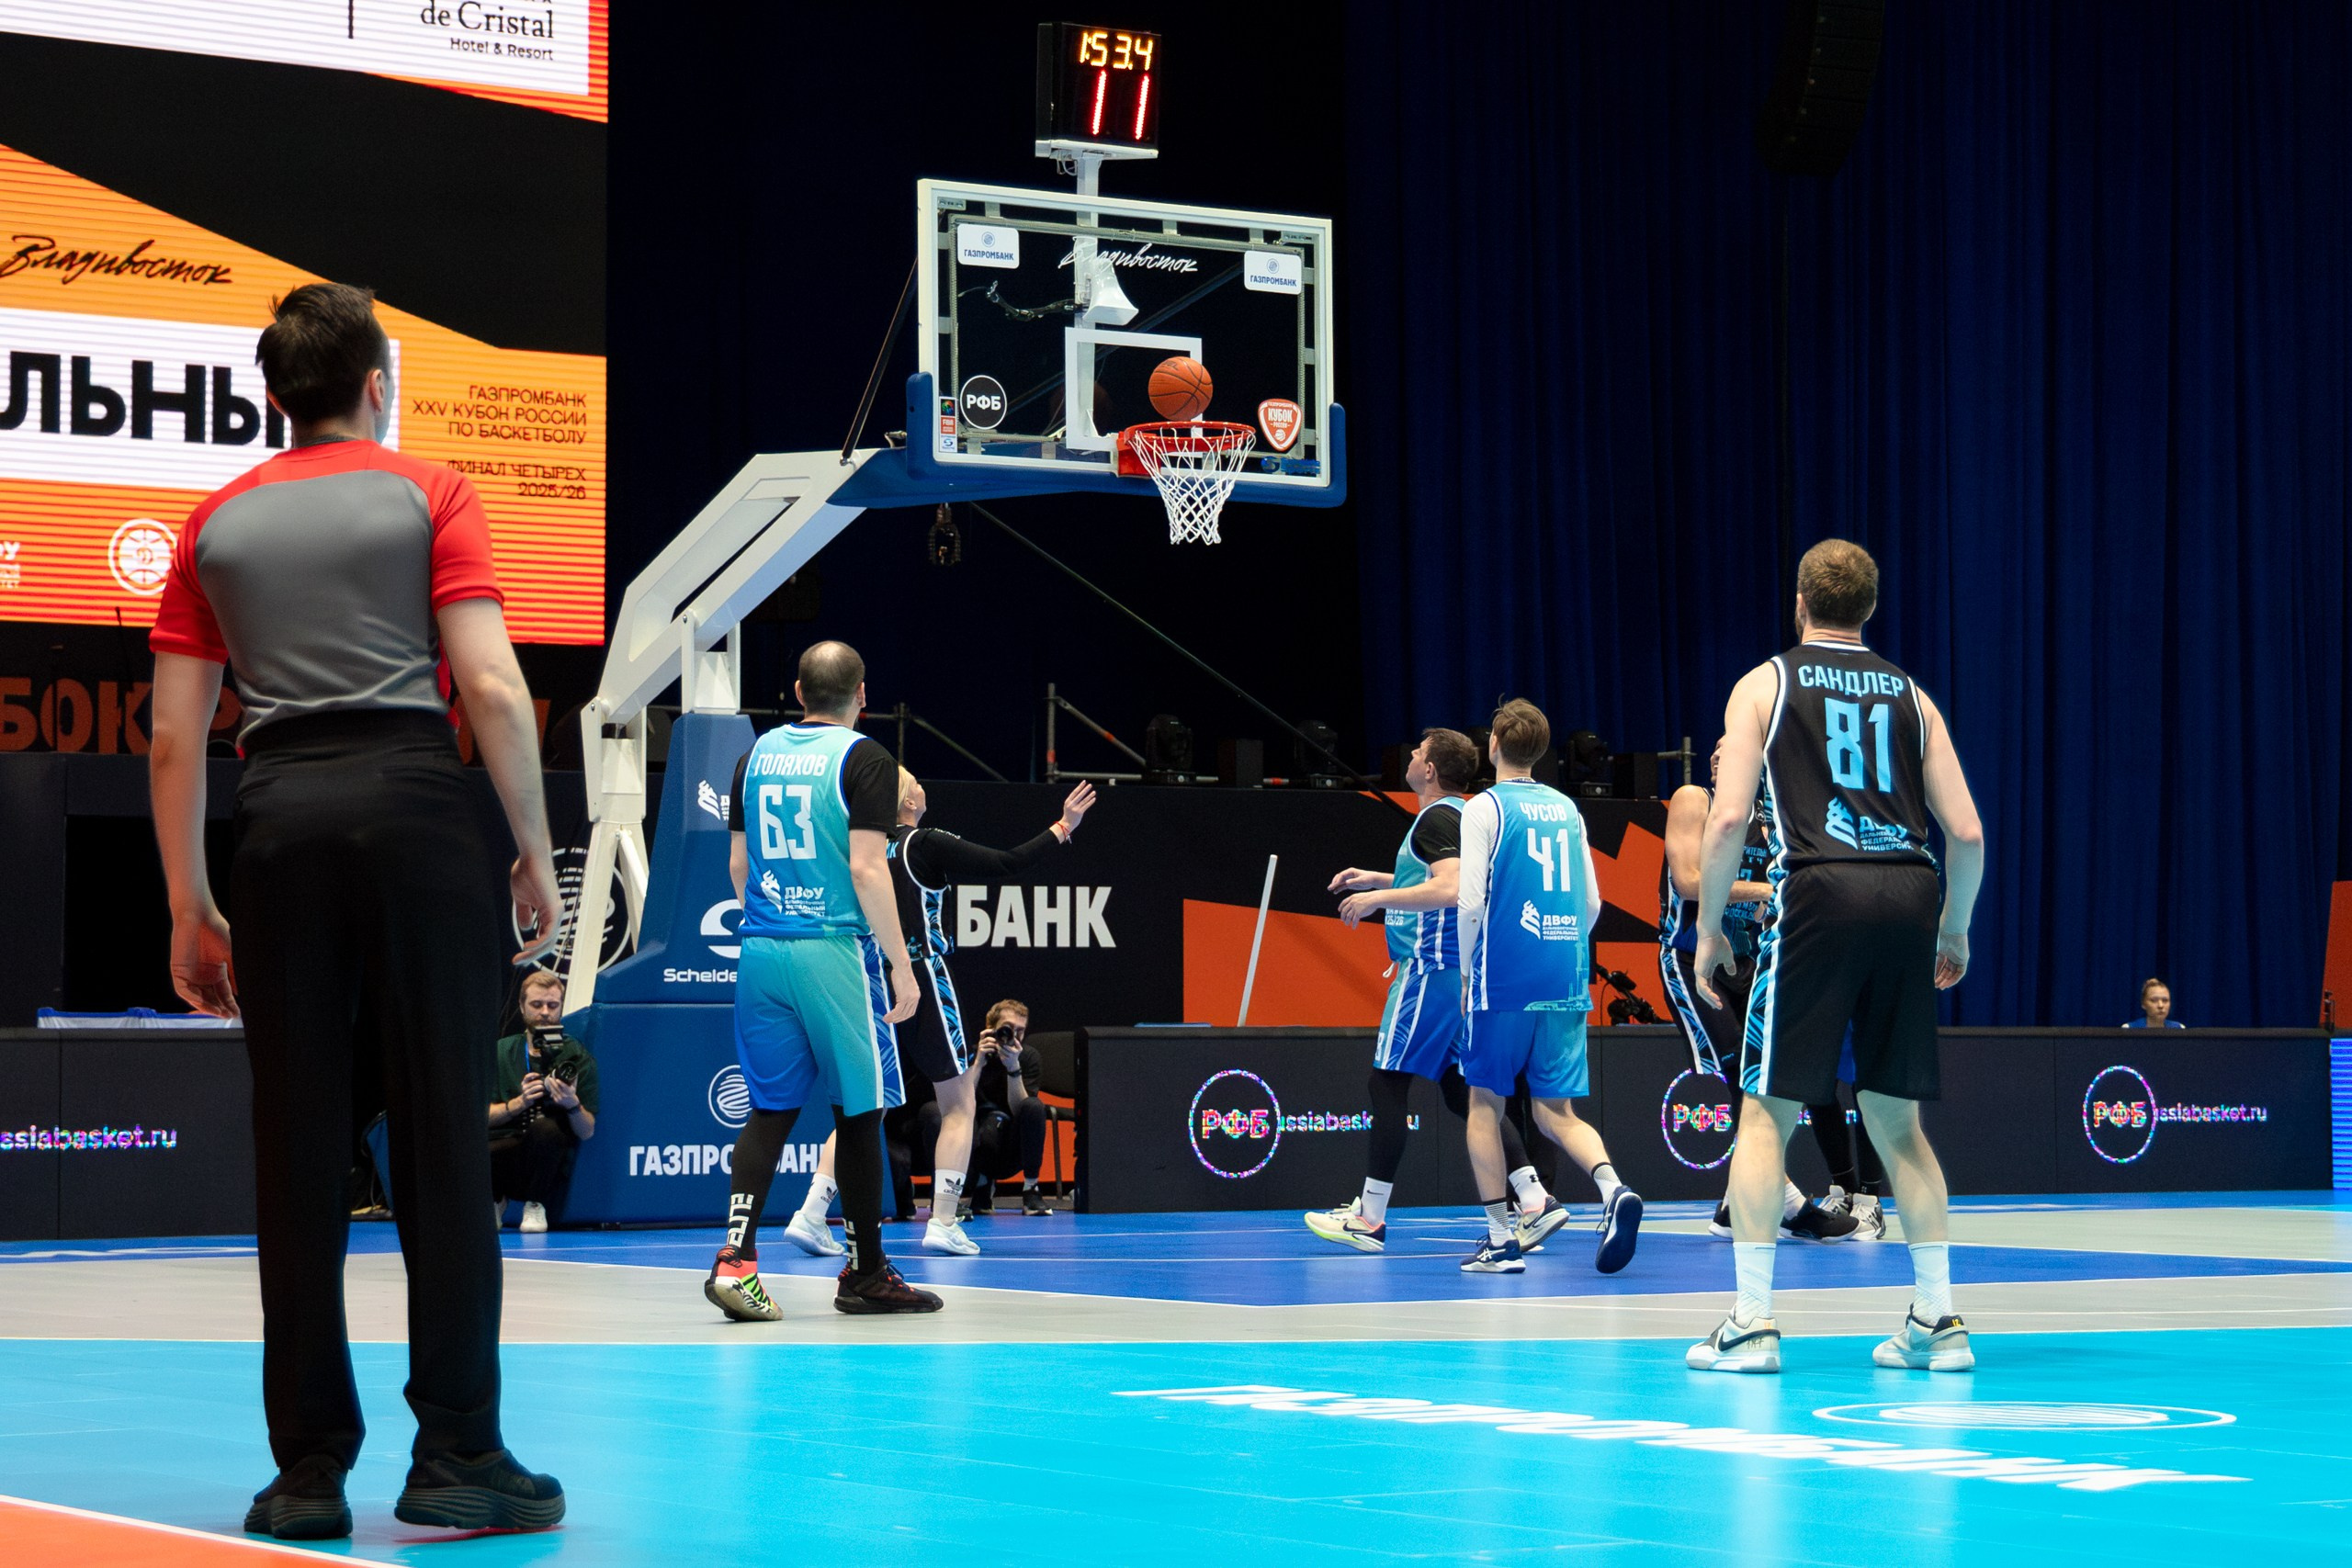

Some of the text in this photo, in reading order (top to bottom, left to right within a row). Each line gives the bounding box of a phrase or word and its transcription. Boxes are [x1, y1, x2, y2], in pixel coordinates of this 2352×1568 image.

[421, 0, 554, 39] de Cristal
[450, 38, 554, 61] Hotel & Resort
[0, 234, 232, 285] Владивосток
[964, 249, 1014, 261] ГАЗПРОМБАНК
[1250, 275, 1297, 288] ГАЗПРОМБАНК
[469, 384, 587, 408] ГАЗПРОМБАНК
[966, 394, 1001, 411] РФБ
[413, 399, 447, 416] XXV
[514, 407, 587, 426] РОССИИ
[1268, 408, 1293, 423] КУБОК
[448, 422, 587, 445] ПО БАСКЕТБОЛУ
[447, 459, 586, 481] ФИНАЛ ЧЕТЫРЕХ
[517, 481, 586, 500] 2025/26
[1798, 665, 1905, 698] САНДЛЕР
[1825, 697, 1891, 793] 81
[753, 753, 828, 777] ГОЛЯХОВ
[759, 784, 817, 860] 63
[1520, 802, 1567, 821] ЧУСОВ
[1527, 828, 1570, 892] 41
[785, 886, 824, 900] ДВФУ
[957, 885, 1117, 947] БАНК
[1543, 915, 1577, 926] ДВФУ
[663, 968, 738, 983] Schelde
[1202, 1109, 1270, 1139] РФБ
[1672, 1104, 1733, 1133] РФБ
[2093, 1101, 2147, 1127] РФБ
[1112, 1384, 2251, 1492] ГАЗПРОМБАНК
